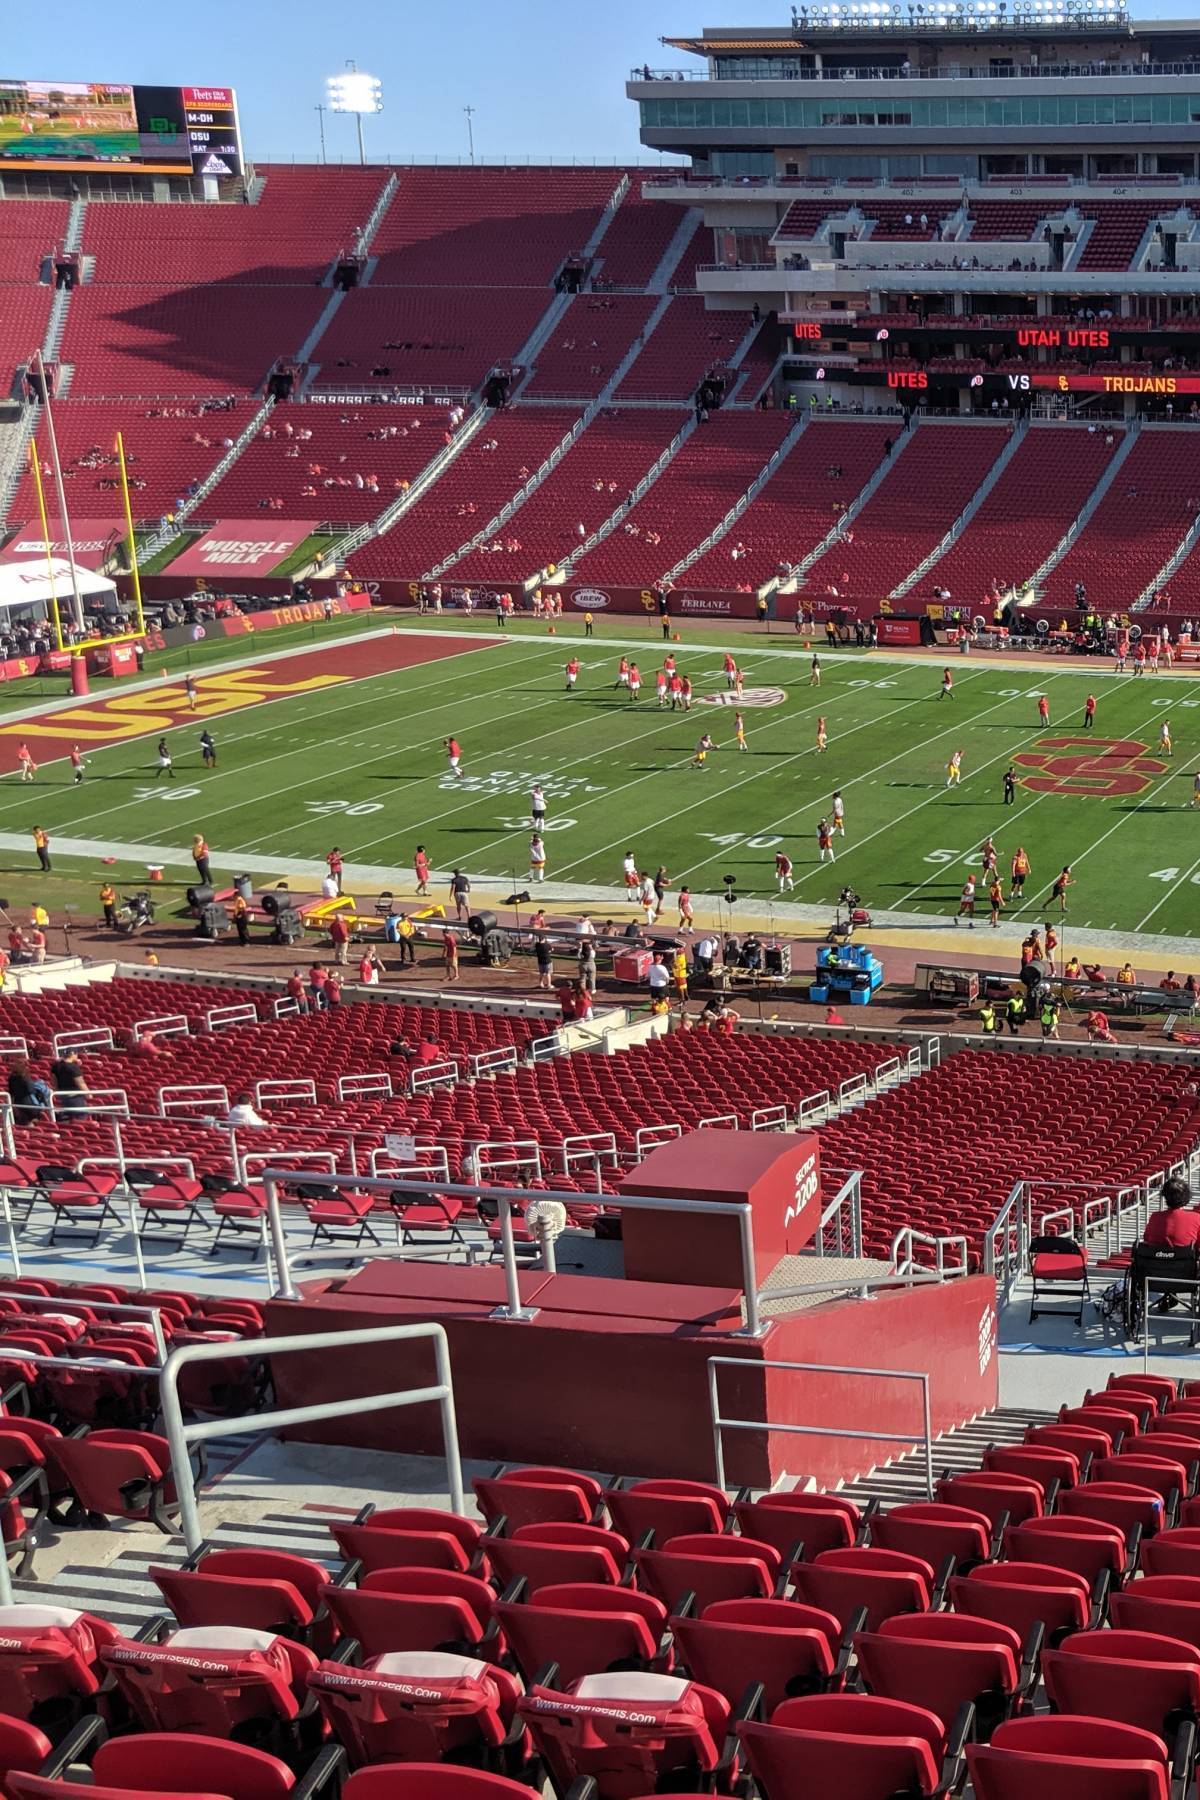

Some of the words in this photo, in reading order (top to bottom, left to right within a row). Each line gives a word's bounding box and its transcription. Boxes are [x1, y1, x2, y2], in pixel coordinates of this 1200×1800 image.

[188, 114, 213, 123] M-OH
[191, 132, 210, 141] OSU
[795, 322, 821, 339] UTES
[1018, 330, 1060, 346] UTAH
[1067, 330, 1109, 347] UTES
[887, 372, 927, 388] UTES
[1009, 375, 1030, 390] VS
[1103, 376, 1177, 393] TROJANS
[200, 540, 294, 554] MUSCLE
[205, 552, 267, 564] MILK
[580, 594, 602, 603] IBEW
[681, 599, 732, 609] TERRANEA
[272, 599, 341, 626] TROJAS
[0, 670, 355, 740] USC
[795, 1153, 816, 1186] SECTION
[795, 1171, 818, 1217] 220B
[115, 1648, 229, 1673] www.trojanseats.com
[324, 1673, 442, 1700] www.trojanseats.com
[535, 1698, 656, 1725] www.trojanseats.com
